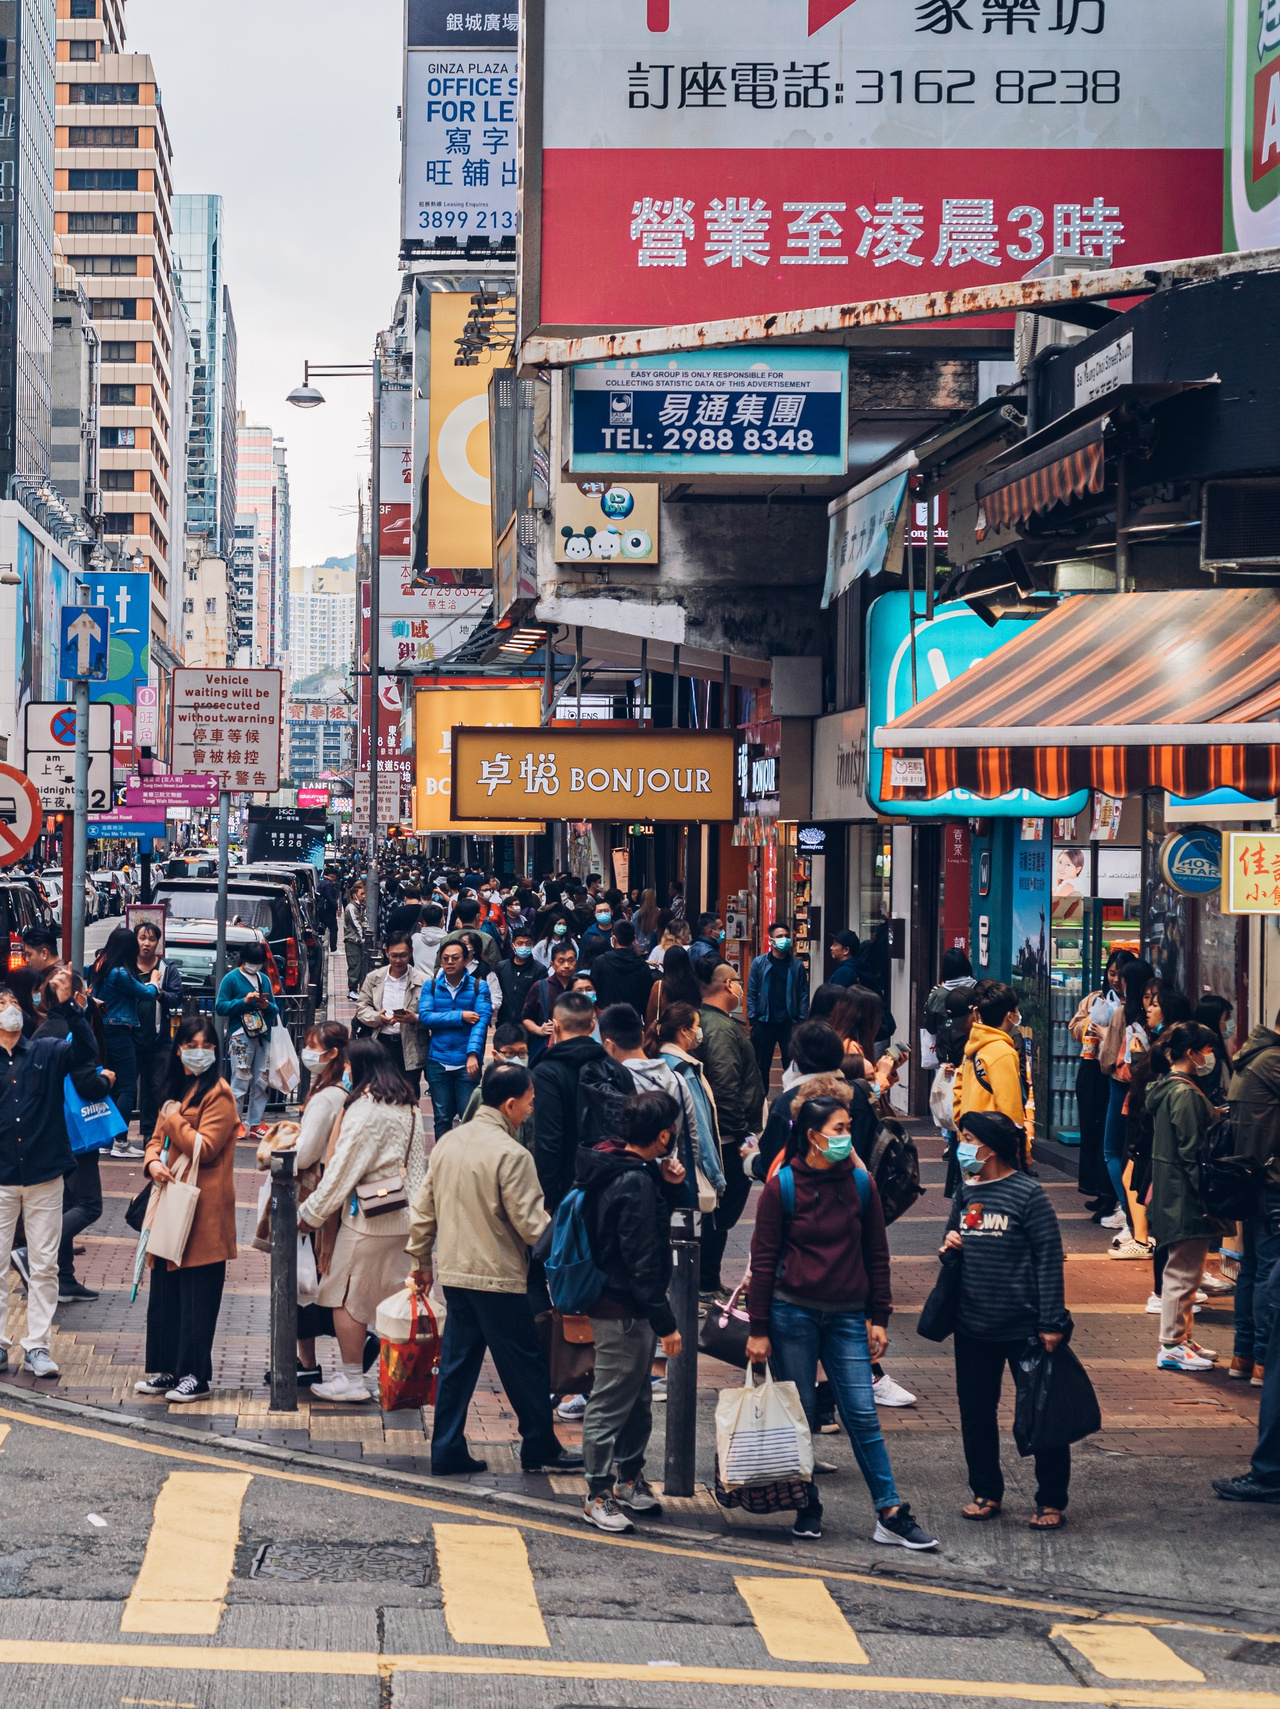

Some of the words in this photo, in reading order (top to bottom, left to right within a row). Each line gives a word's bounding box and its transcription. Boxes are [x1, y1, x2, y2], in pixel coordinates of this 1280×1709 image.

[446, 13, 518, 32] 銀城廣場
[428, 63, 465, 75] GINZA
[468, 63, 509, 75] PLAZA
[427, 78, 505, 97] OFFICE
[508, 78, 518, 97] S
[859, 69, 976, 106] 3162
[996, 69, 1121, 106] 8238
[426, 100, 475, 123] FOR
[483, 100, 518, 123] LE
[445, 127, 509, 155] 寫字
[465, 201, 489, 209] Enquires
[419, 210, 468, 229] 3899
[631, 196, 1126, 268] 營業至凌晨3時
[690, 371, 711, 379] ONLY
[605, 379, 654, 387] COLLECTING
[728, 380, 746, 388] THIS
[746, 380, 811, 388] ADVERTISEMENT
[658, 394, 807, 427] 易通集團
[601, 428, 654, 449] TEL:
[663, 428, 734, 450] 2988
[743, 429, 814, 451] 8348
[379, 506, 391, 515] 3F
[428, 599, 457, 610] 蔡生洽
[392, 620, 429, 639] 動感
[206, 674, 249, 685] Vehicle
[185, 687, 228, 698] waiting
[232, 687, 252, 698] will
[255, 688, 270, 698] be
[193, 700, 260, 711] prosecuted
[178, 713, 224, 722] without
[228, 714, 275, 725] warning
[139, 711, 155, 742] 旺角
[192, 728, 260, 744] 停車等候
[192, 749, 259, 765] 會被檢控
[41, 764, 65, 775] 上午
[570, 767, 712, 797] BONJOUR
[41, 797, 65, 808] 午夜
[1175, 867, 1219, 876] STAR
[1181, 860, 1215, 870] HOT
